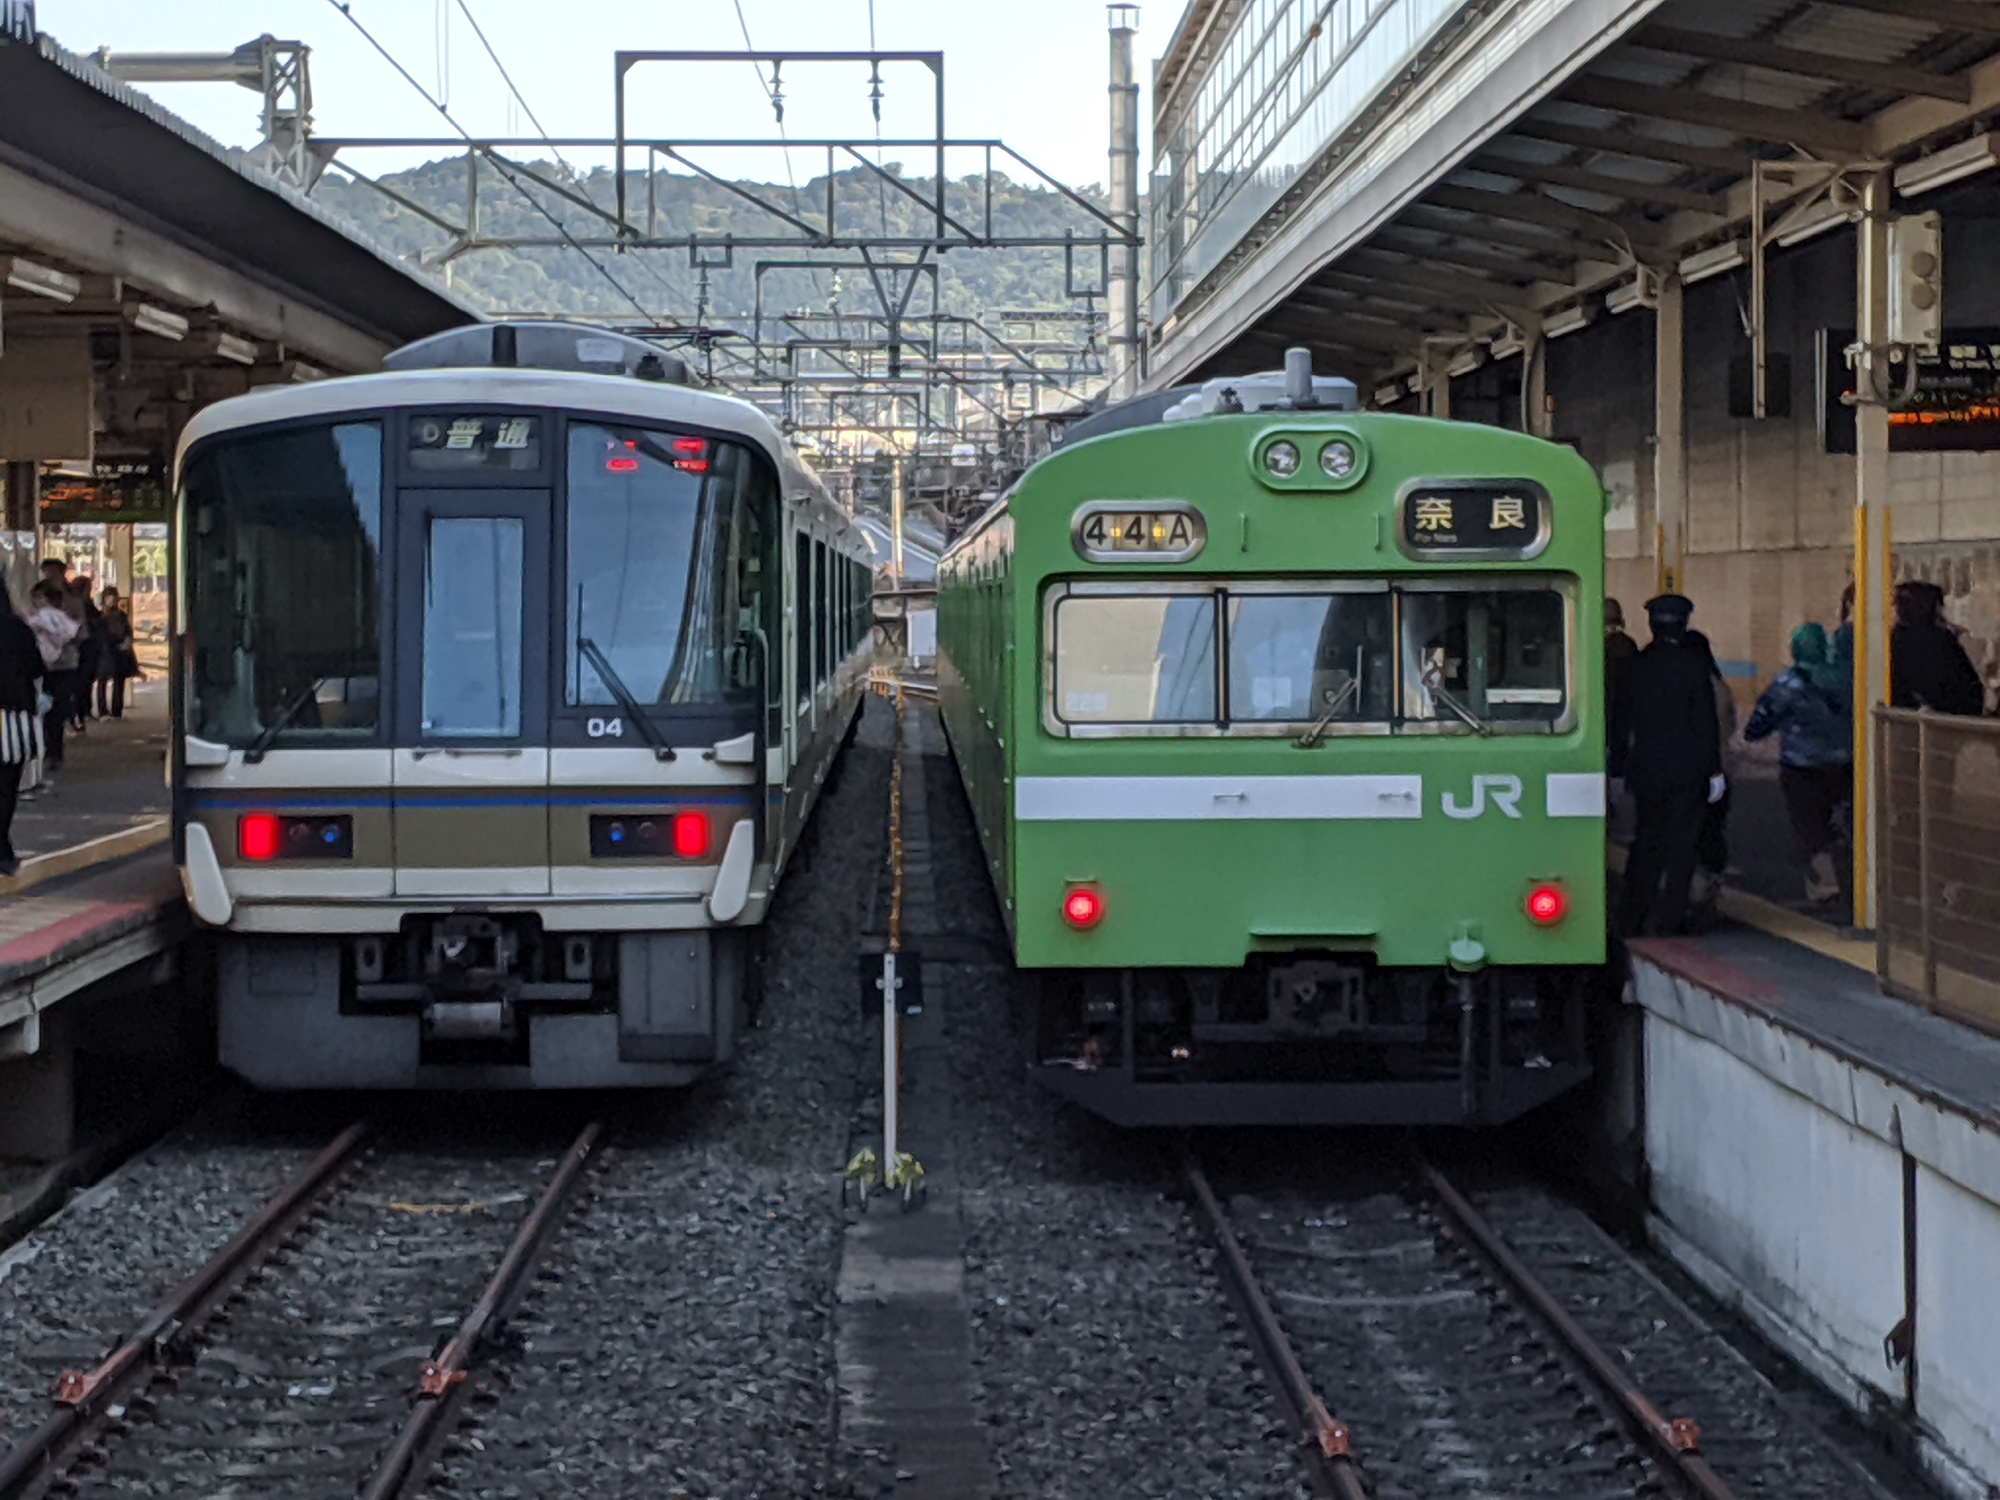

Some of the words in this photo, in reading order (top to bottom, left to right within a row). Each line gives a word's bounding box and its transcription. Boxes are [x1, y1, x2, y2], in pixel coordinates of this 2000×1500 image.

[446, 419, 530, 449] 普通
[1415, 495, 1526, 531] 奈良
[587, 717, 623, 738] 04
[1442, 774, 1523, 819] JR
